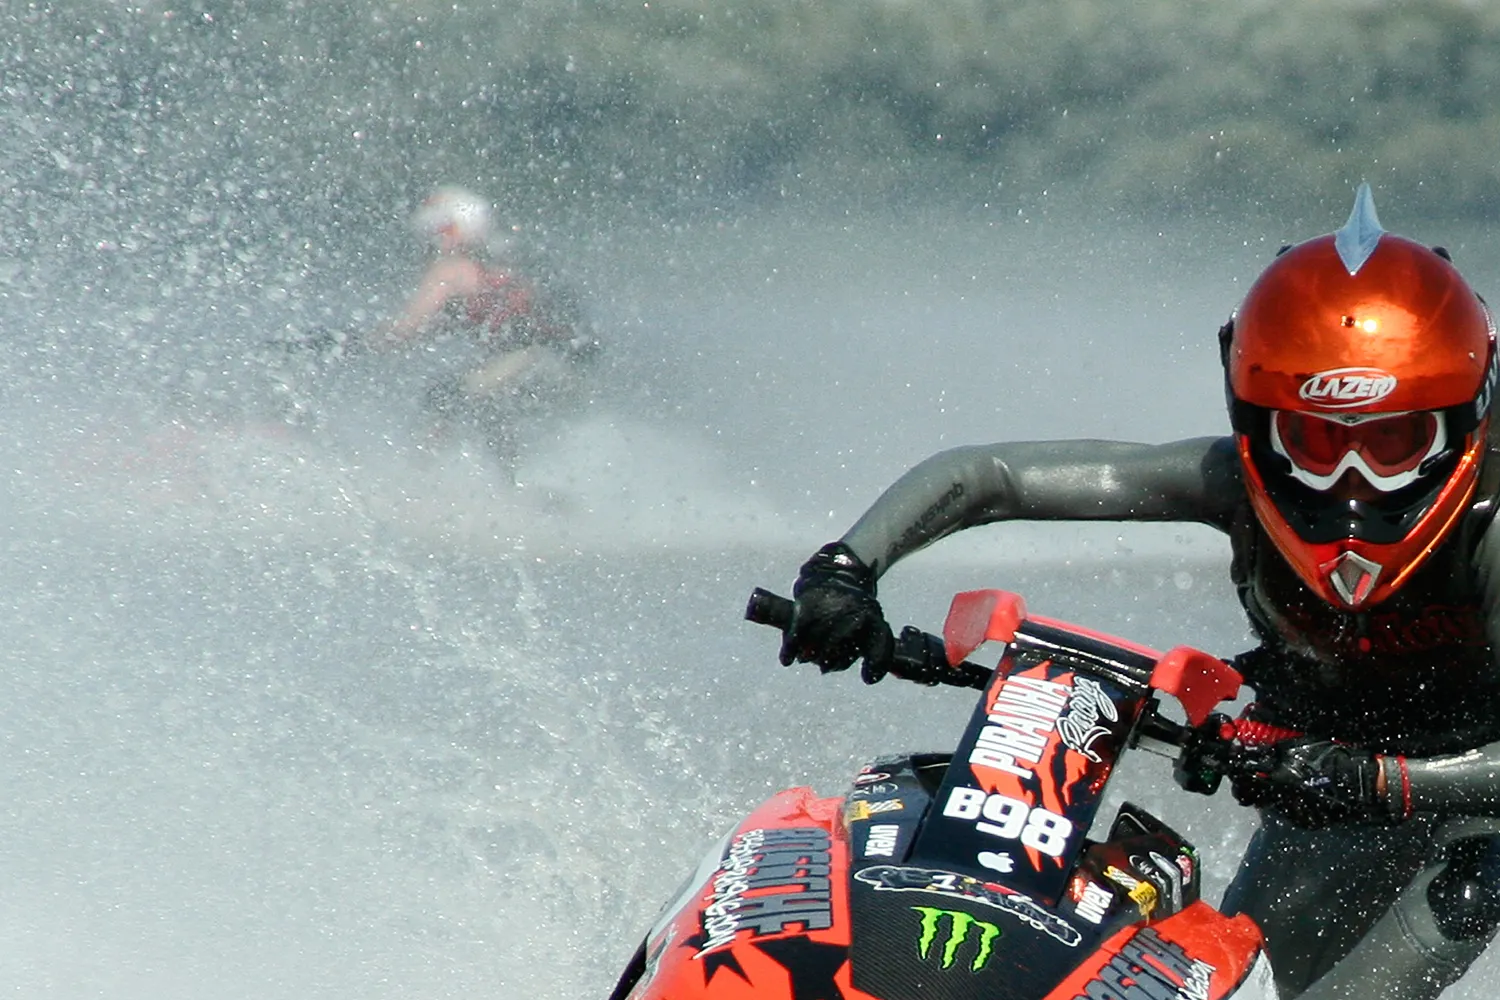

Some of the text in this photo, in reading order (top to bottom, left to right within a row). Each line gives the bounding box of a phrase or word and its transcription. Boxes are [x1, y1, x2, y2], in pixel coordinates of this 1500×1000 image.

[1308, 374, 1394, 399] LAZER
[968, 675, 1073, 780] PIRANHA
[1056, 675, 1119, 763] Racing
[864, 824, 899, 856] uvex
[943, 786, 1073, 857] B98
[1074, 881, 1114, 924] uvex
